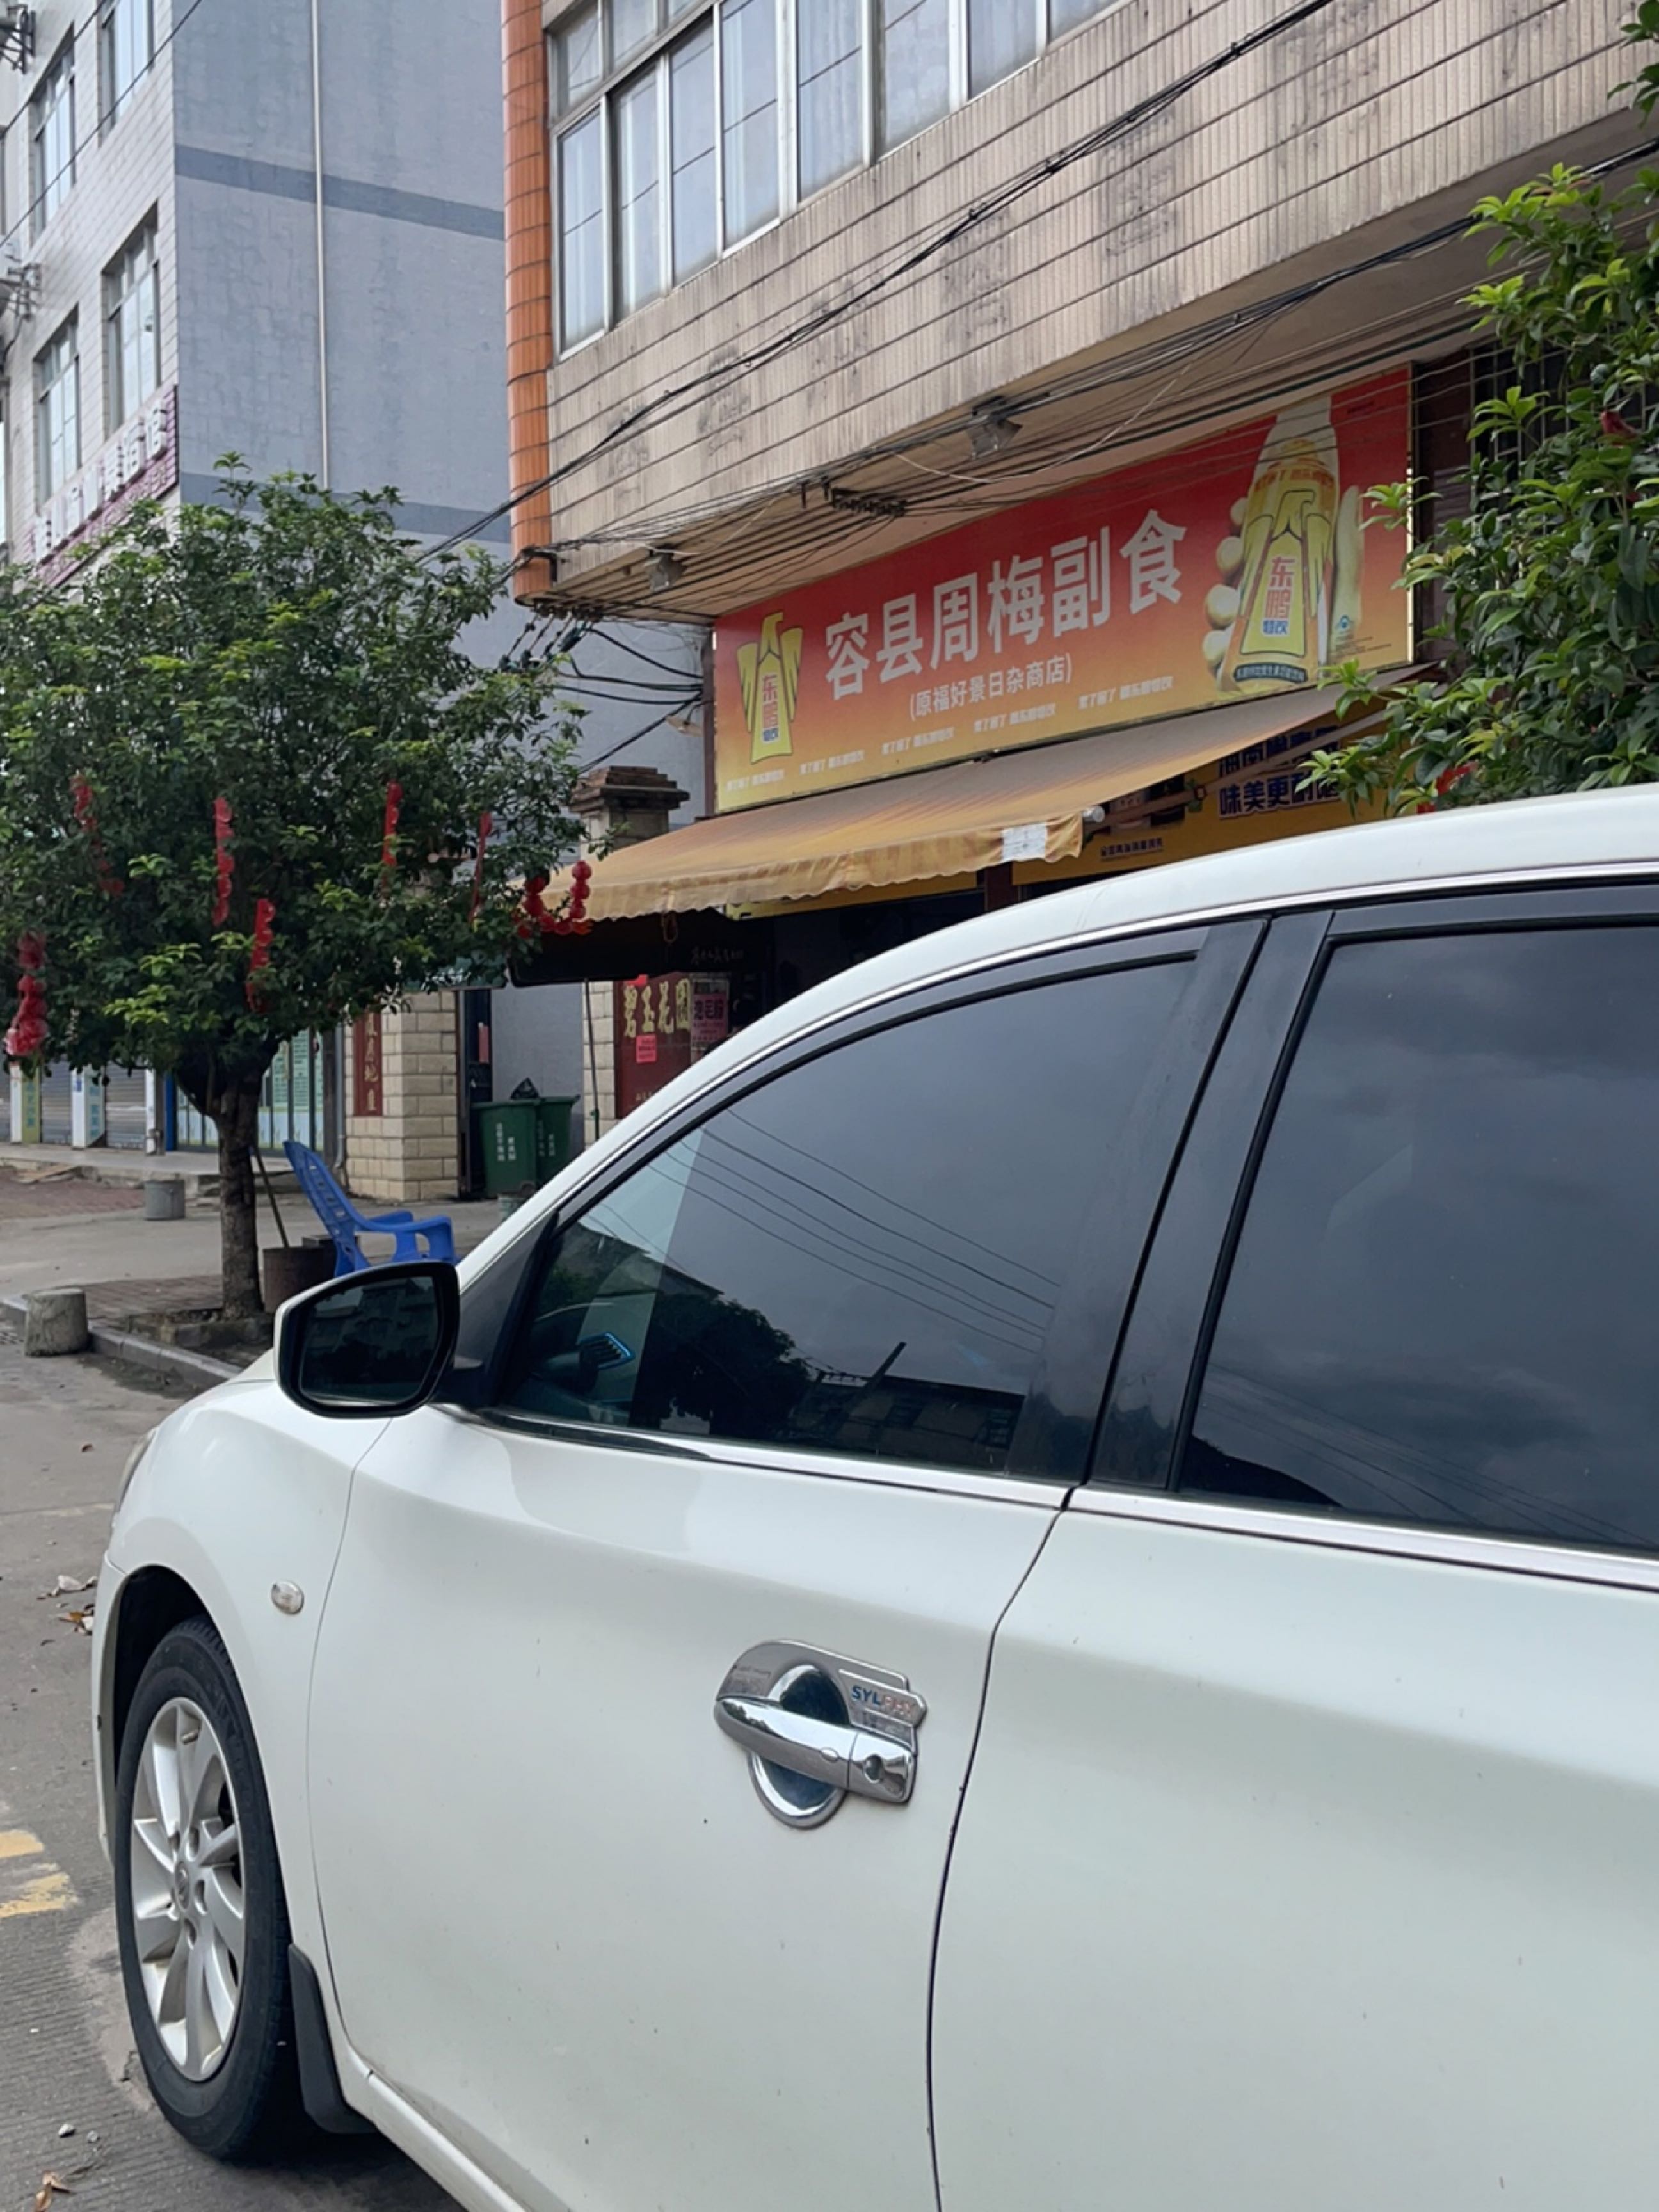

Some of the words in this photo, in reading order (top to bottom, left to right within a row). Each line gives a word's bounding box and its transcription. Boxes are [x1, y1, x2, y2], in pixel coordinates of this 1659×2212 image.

[825, 508, 1188, 701] 容县周梅副食
[910, 653, 1072, 722] (原福好景日杂商店)
